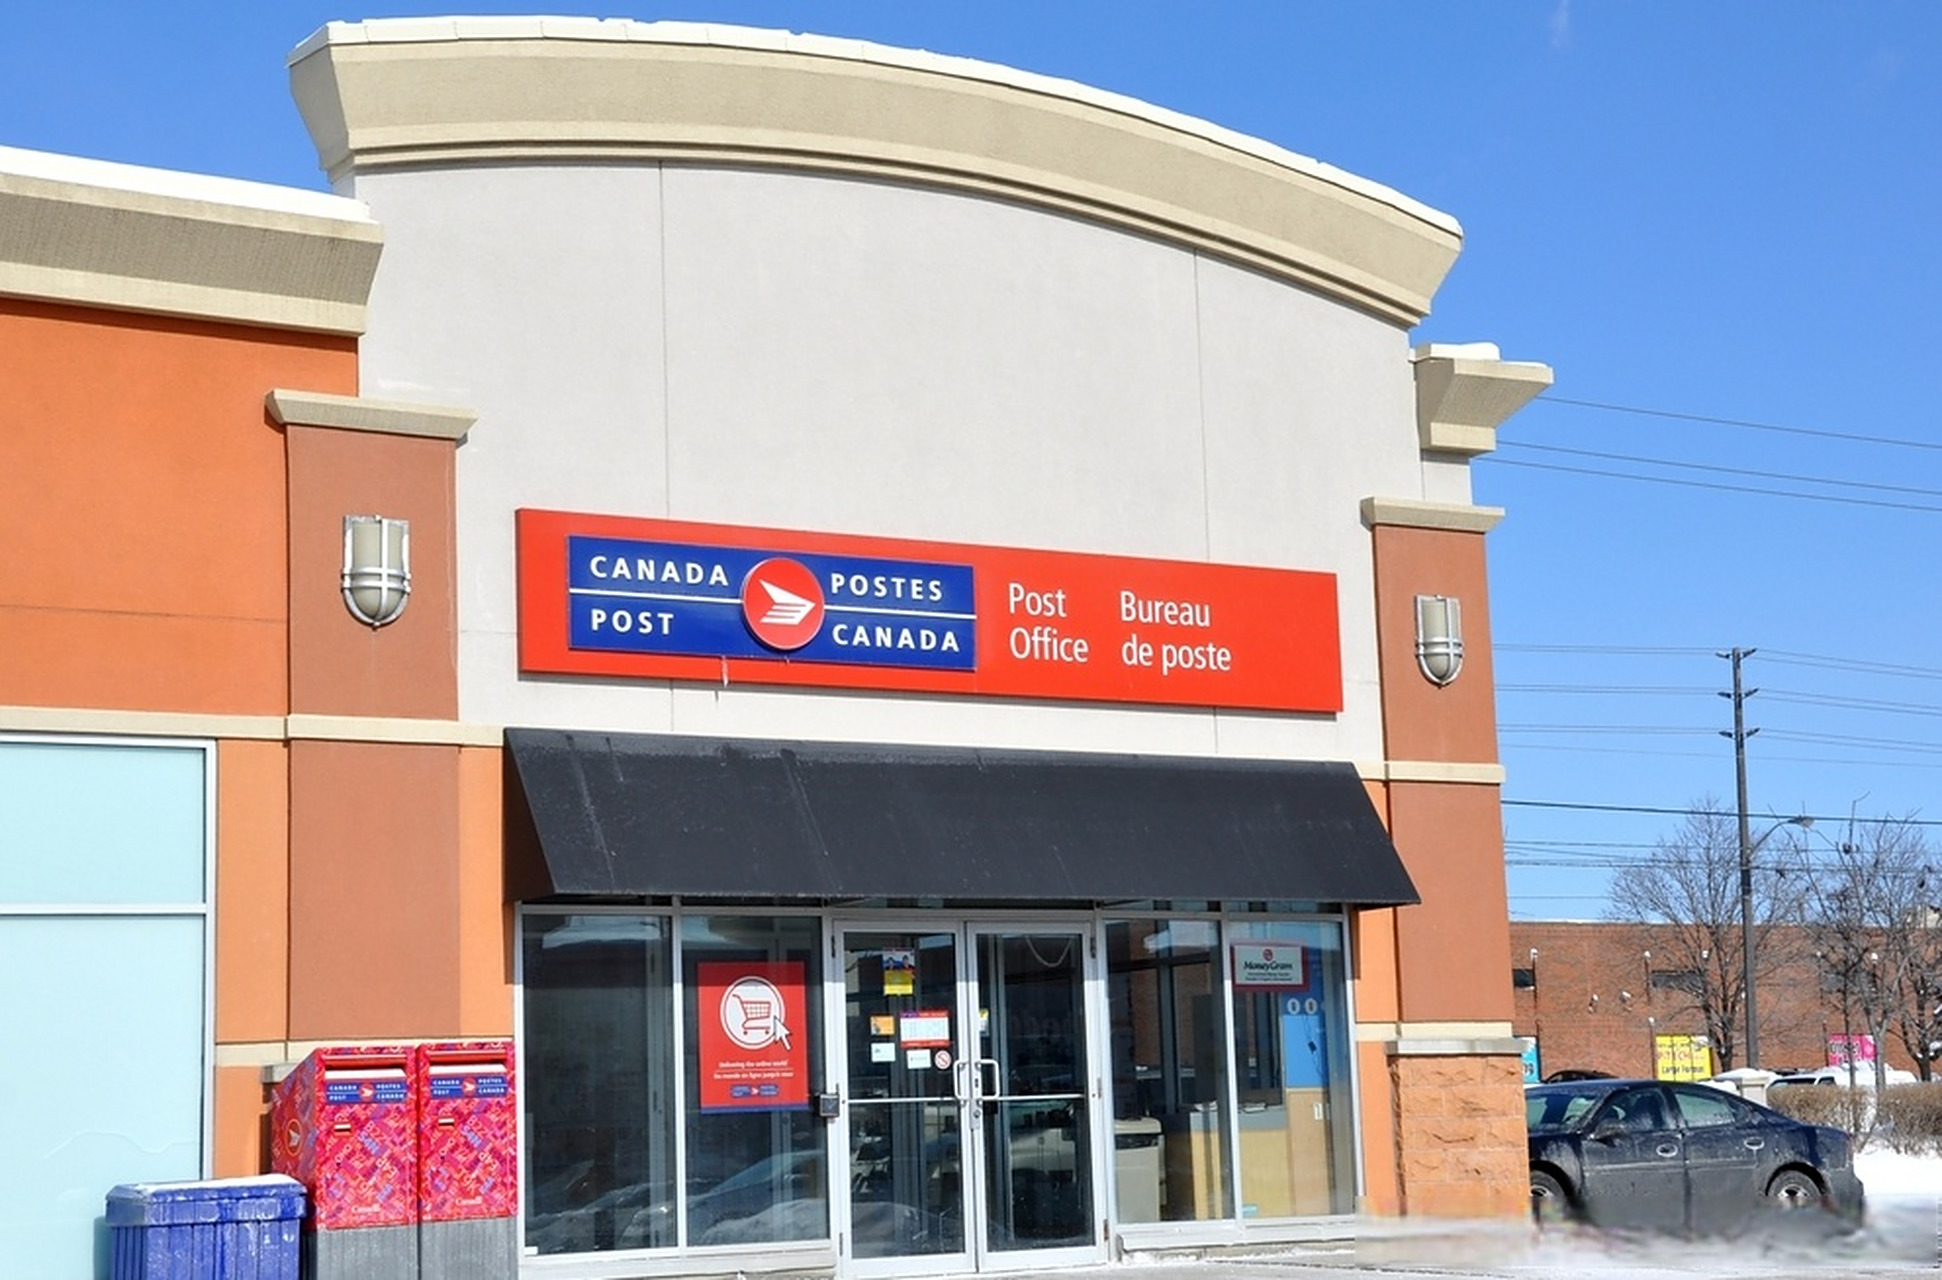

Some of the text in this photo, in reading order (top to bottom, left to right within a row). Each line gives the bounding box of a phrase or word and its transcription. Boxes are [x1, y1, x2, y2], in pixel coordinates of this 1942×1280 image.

[589, 556, 729, 587] CANADA
[831, 573, 943, 601] POSTES
[1009, 583, 1067, 618] Post
[1120, 591, 1211, 628] Bureau
[590, 609, 675, 635] POST
[832, 624, 960, 653] CANADA
[1010, 627, 1090, 663] Office
[1122, 633, 1232, 676] de poste
[1244, 961, 1292, 970] MoneyGram
